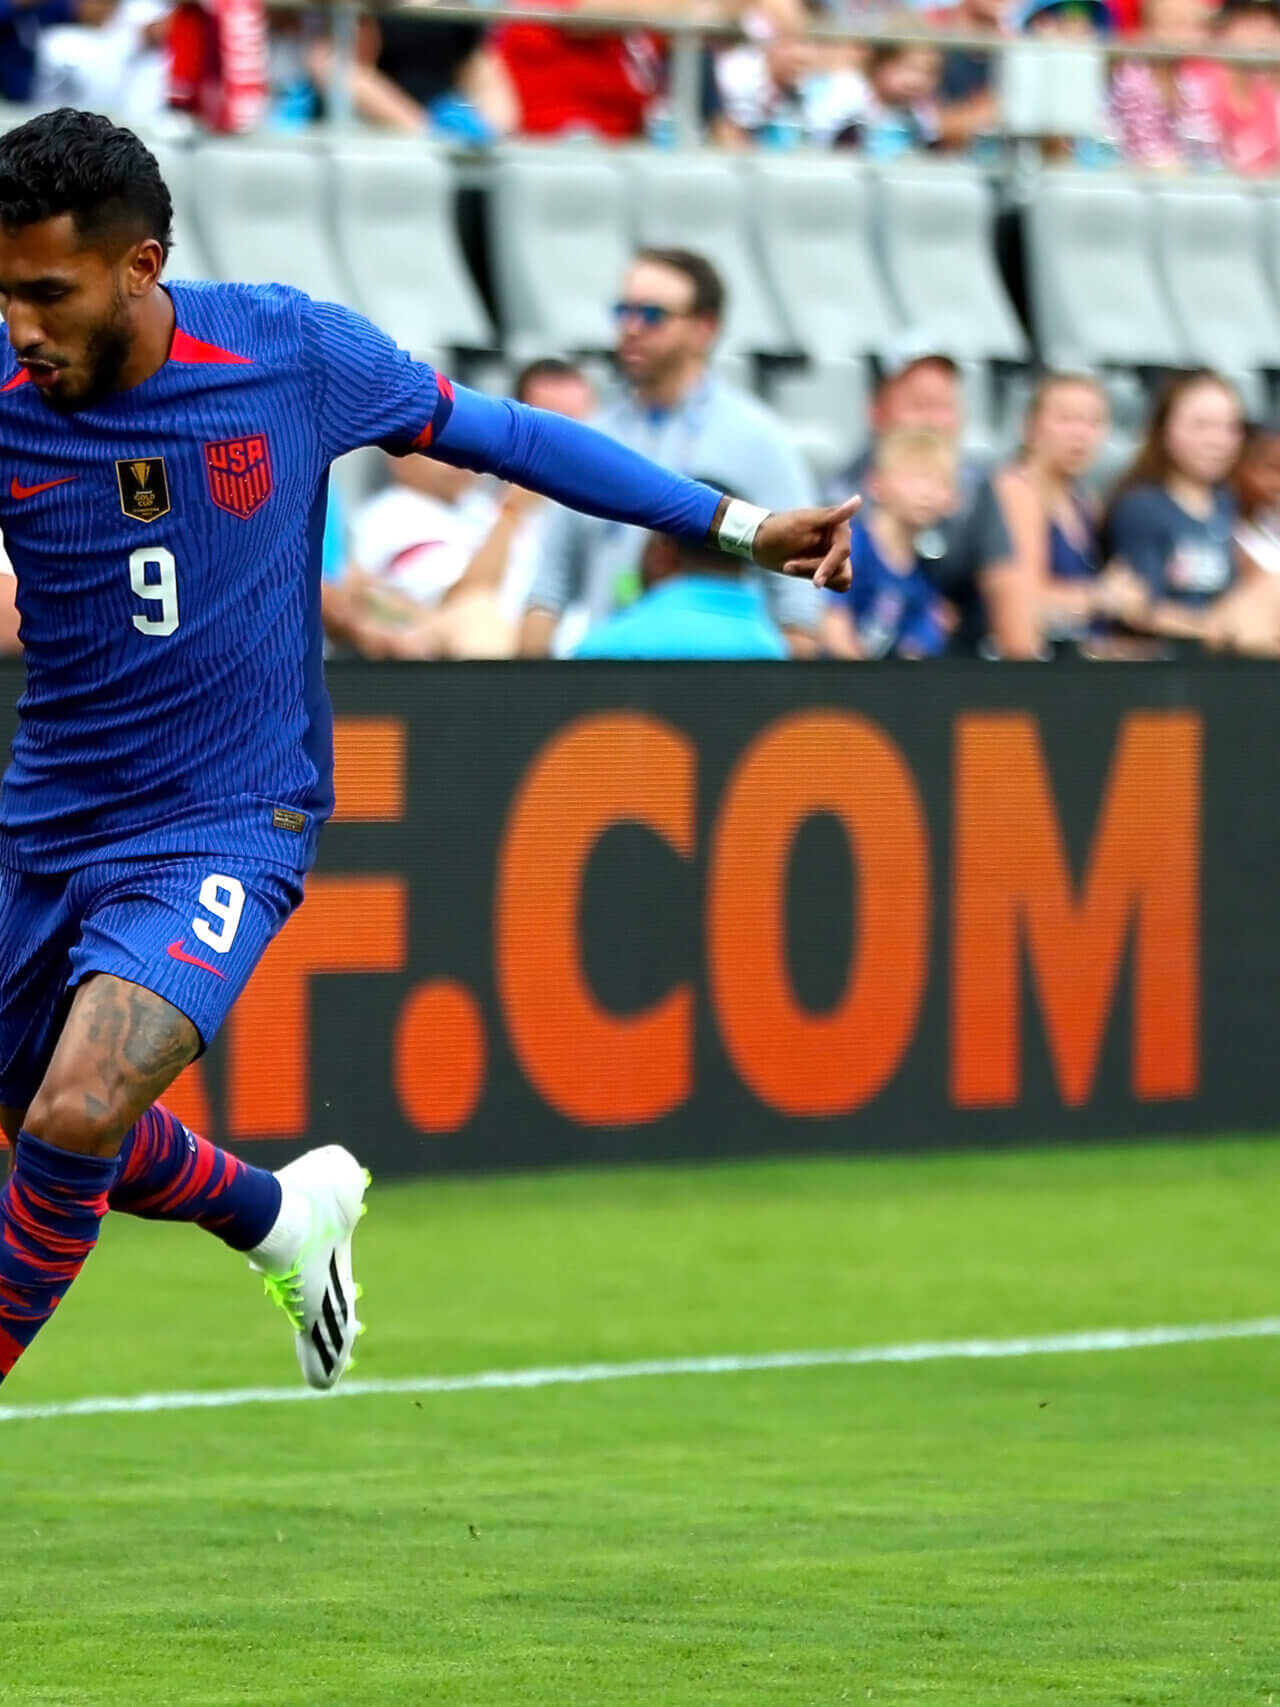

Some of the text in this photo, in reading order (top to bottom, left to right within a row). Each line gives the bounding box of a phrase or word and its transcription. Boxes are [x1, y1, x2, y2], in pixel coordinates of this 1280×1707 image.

[211, 440, 263, 472] USA
[129, 547, 179, 636] 9
[192, 874, 246, 954] 9
